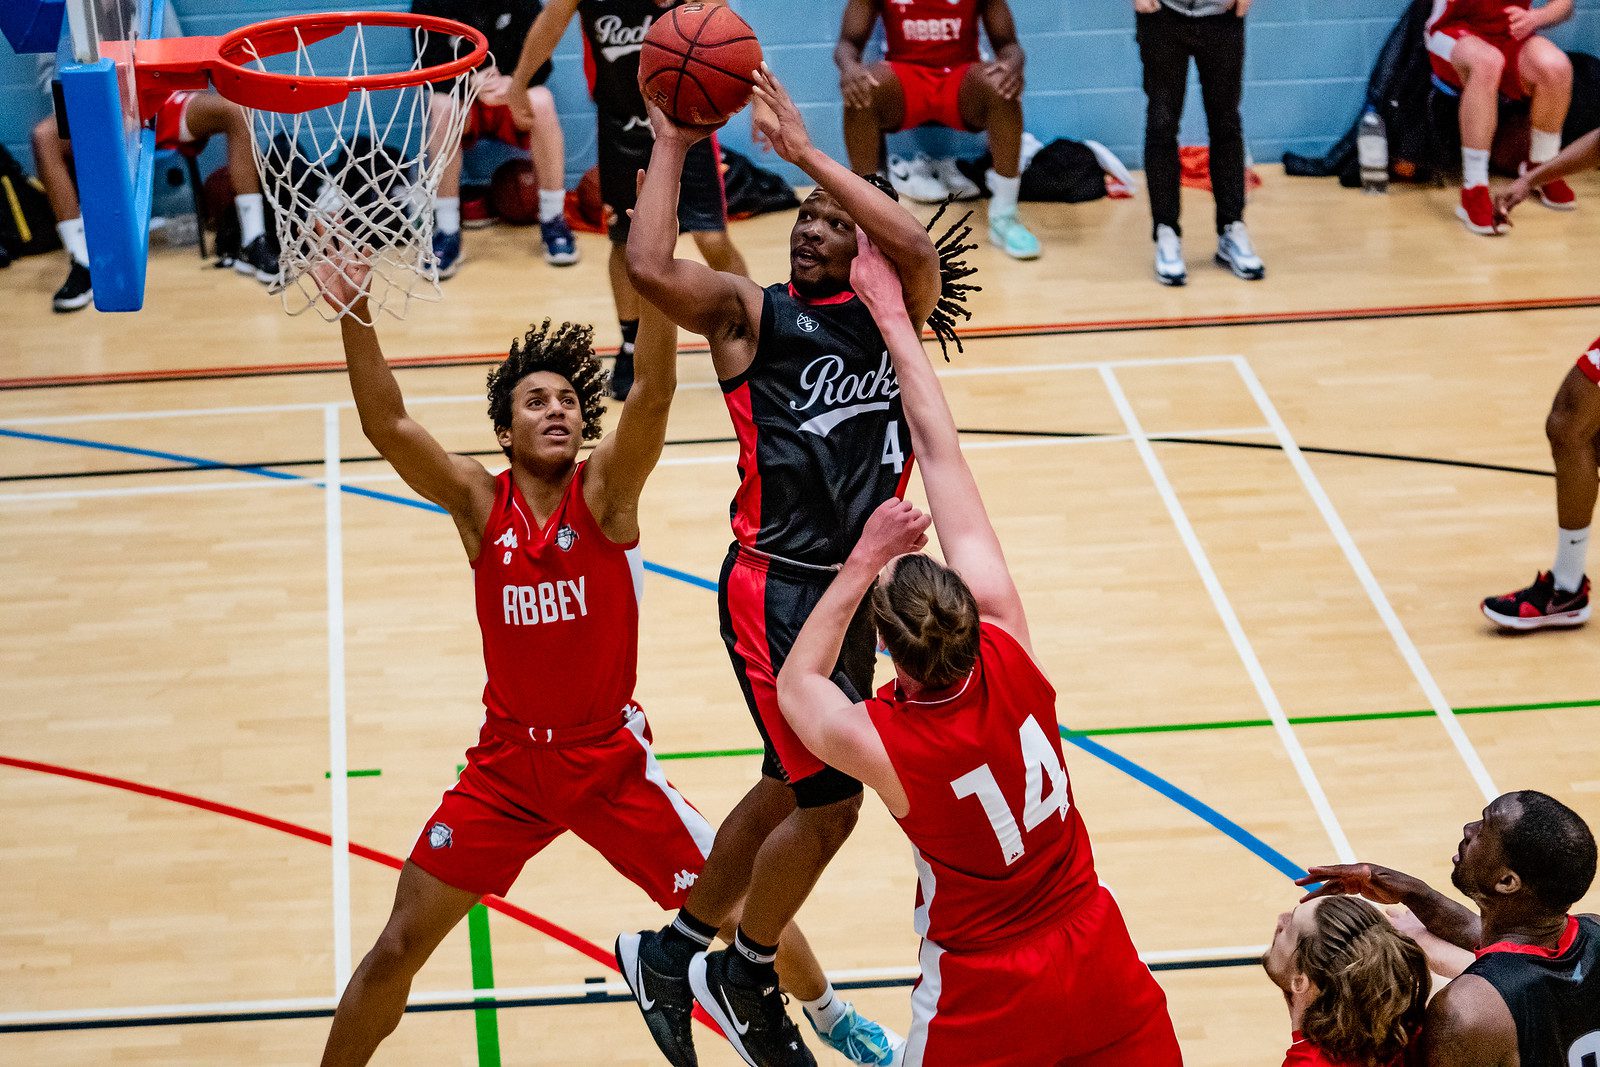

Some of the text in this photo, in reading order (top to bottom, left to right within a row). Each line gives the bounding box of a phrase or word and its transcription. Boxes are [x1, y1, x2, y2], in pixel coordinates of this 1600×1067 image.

[881, 420, 904, 474] 4
[503, 551, 512, 565] 8
[502, 575, 588, 626] ABBEY
[950, 713, 1070, 866] 14
